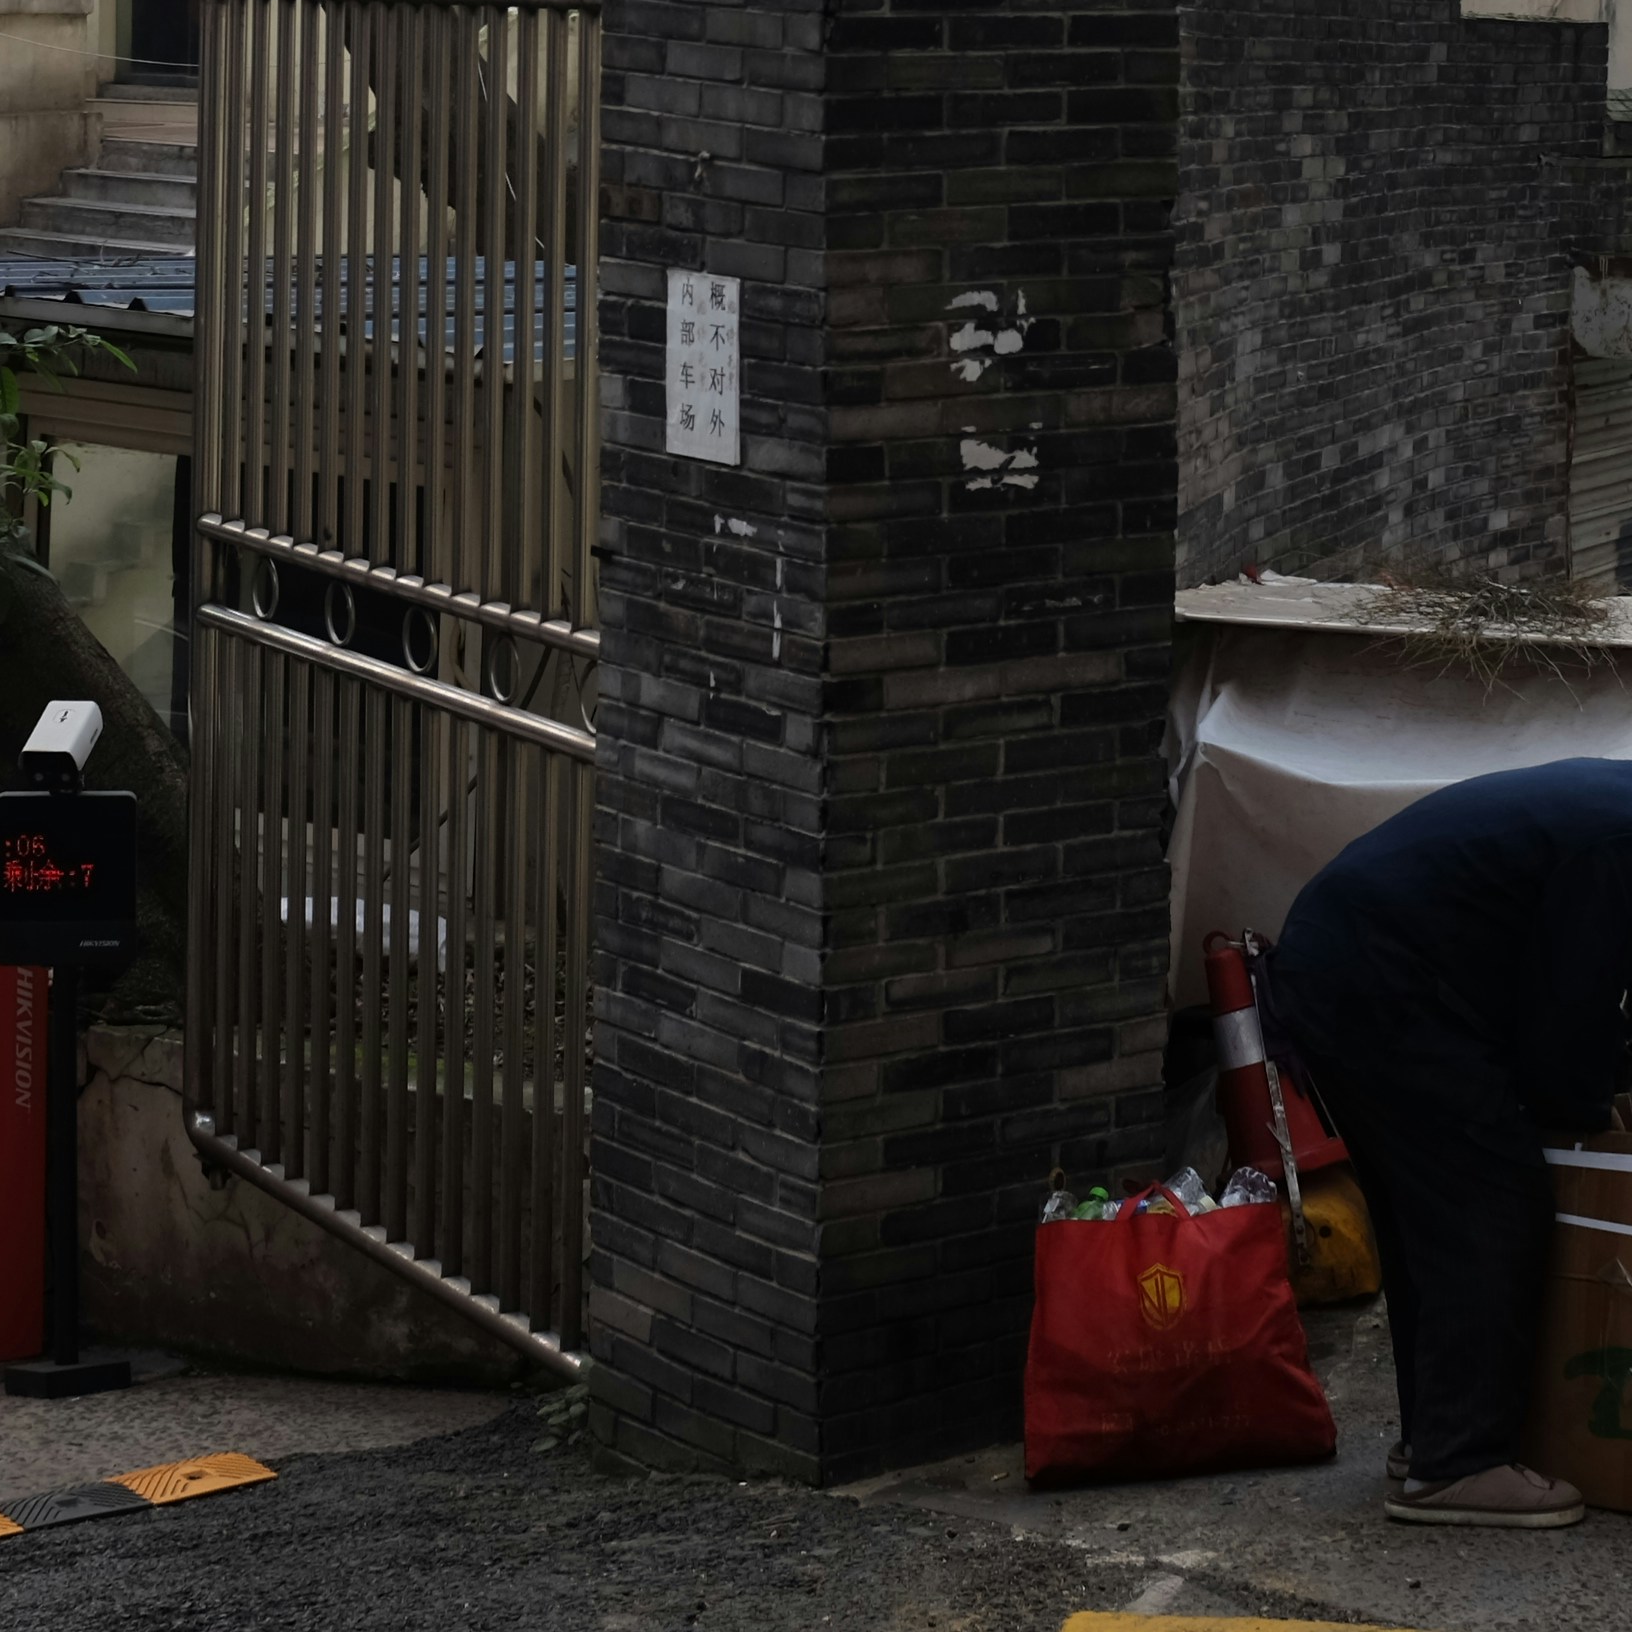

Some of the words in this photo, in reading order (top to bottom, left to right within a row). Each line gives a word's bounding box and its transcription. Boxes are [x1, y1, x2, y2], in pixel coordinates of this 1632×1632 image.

[679, 277, 696, 432] 内部车场
[709, 281, 726, 438] 概不对外
[14, 966, 35, 1106] HIKVISION
